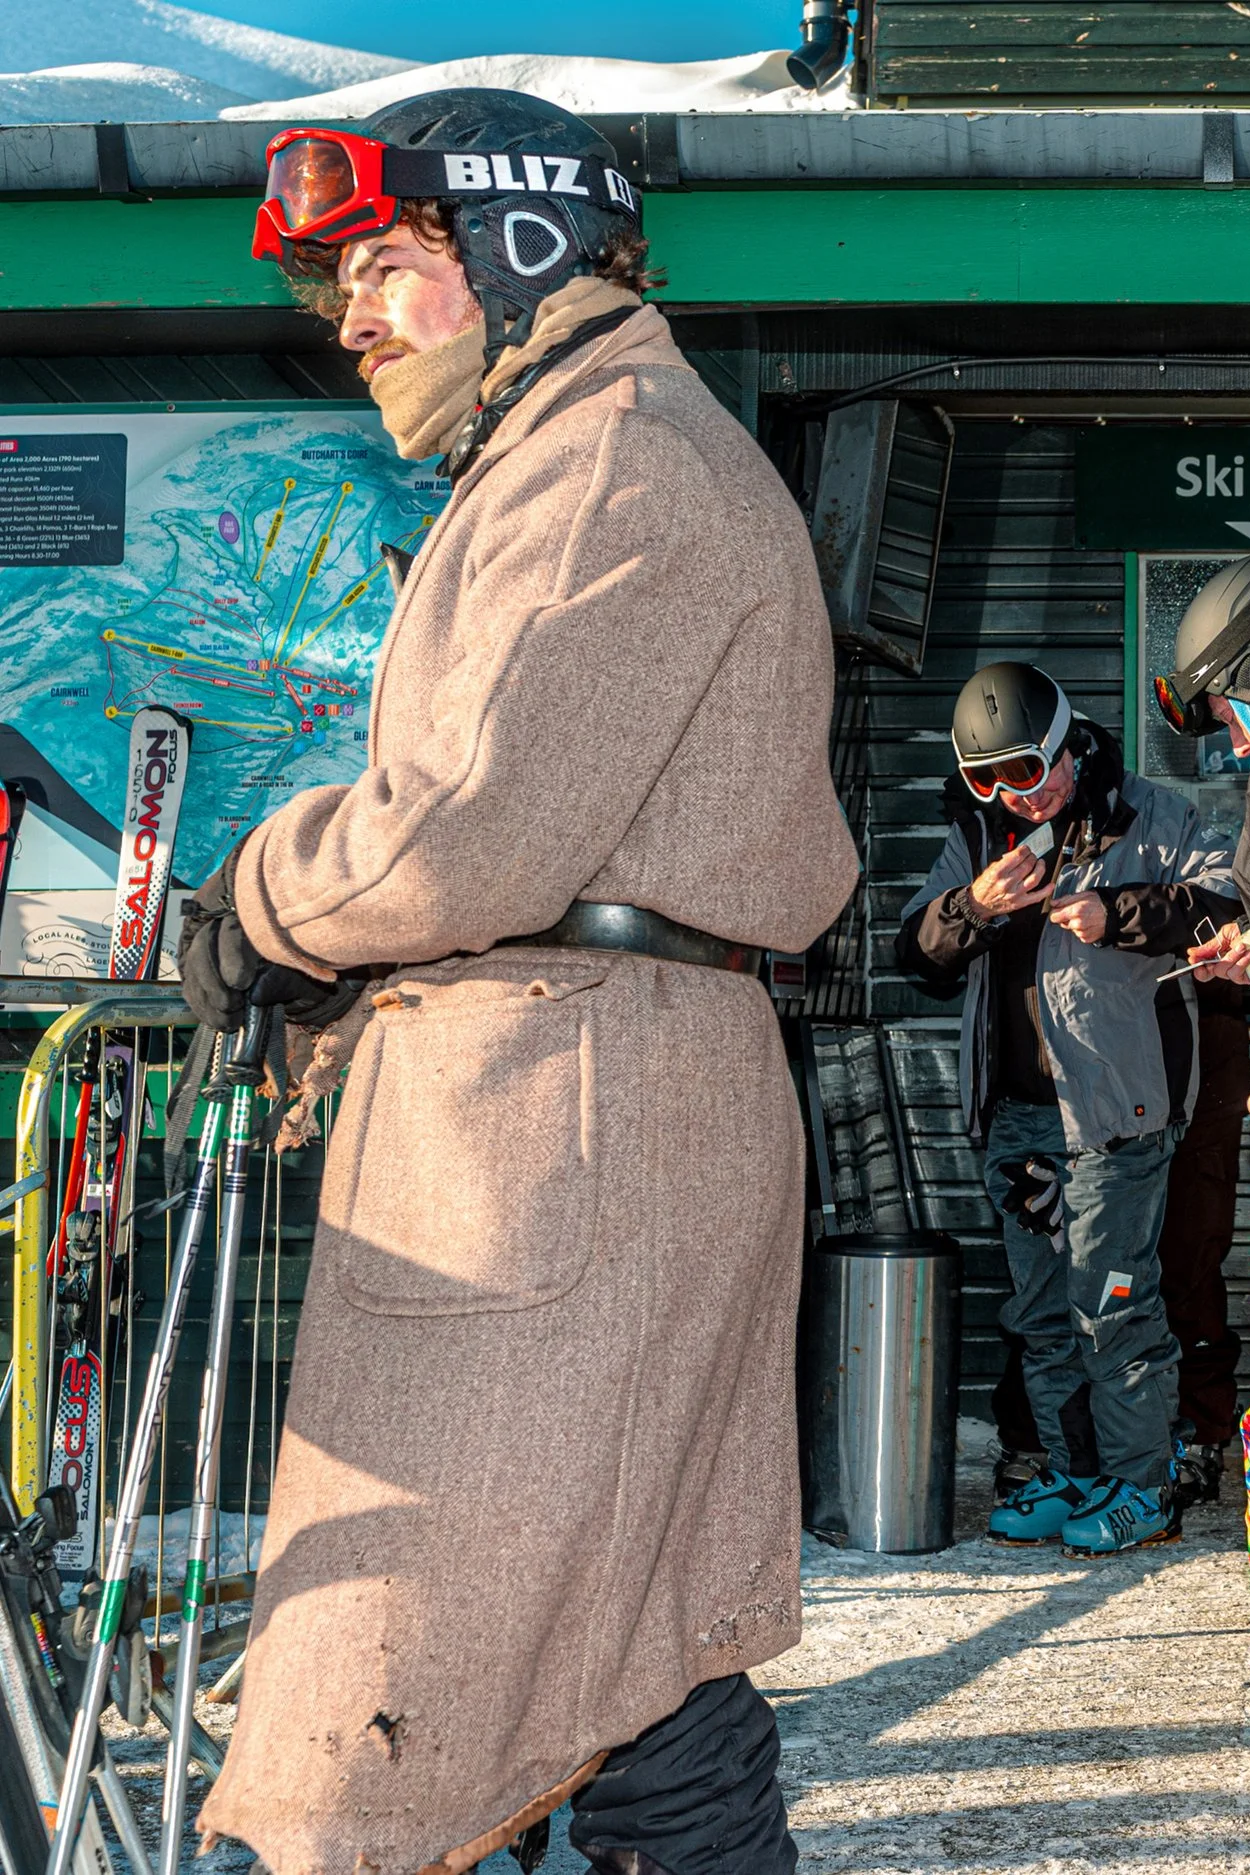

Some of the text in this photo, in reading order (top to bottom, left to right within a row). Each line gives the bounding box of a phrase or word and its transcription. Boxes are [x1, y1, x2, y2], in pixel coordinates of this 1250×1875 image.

[443, 153, 590, 197] BLIZ
[1175, 455, 1244, 497] Ski
[50, 687, 90, 698] CAIRNWELL
[166, 729, 178, 784] FOCUS
[119, 729, 170, 949] SALOMON
[32, 931, 62, 944] LOCAL
[61, 1357, 91, 1492] OCUS
[80, 1441, 94, 1520] SALOMON
